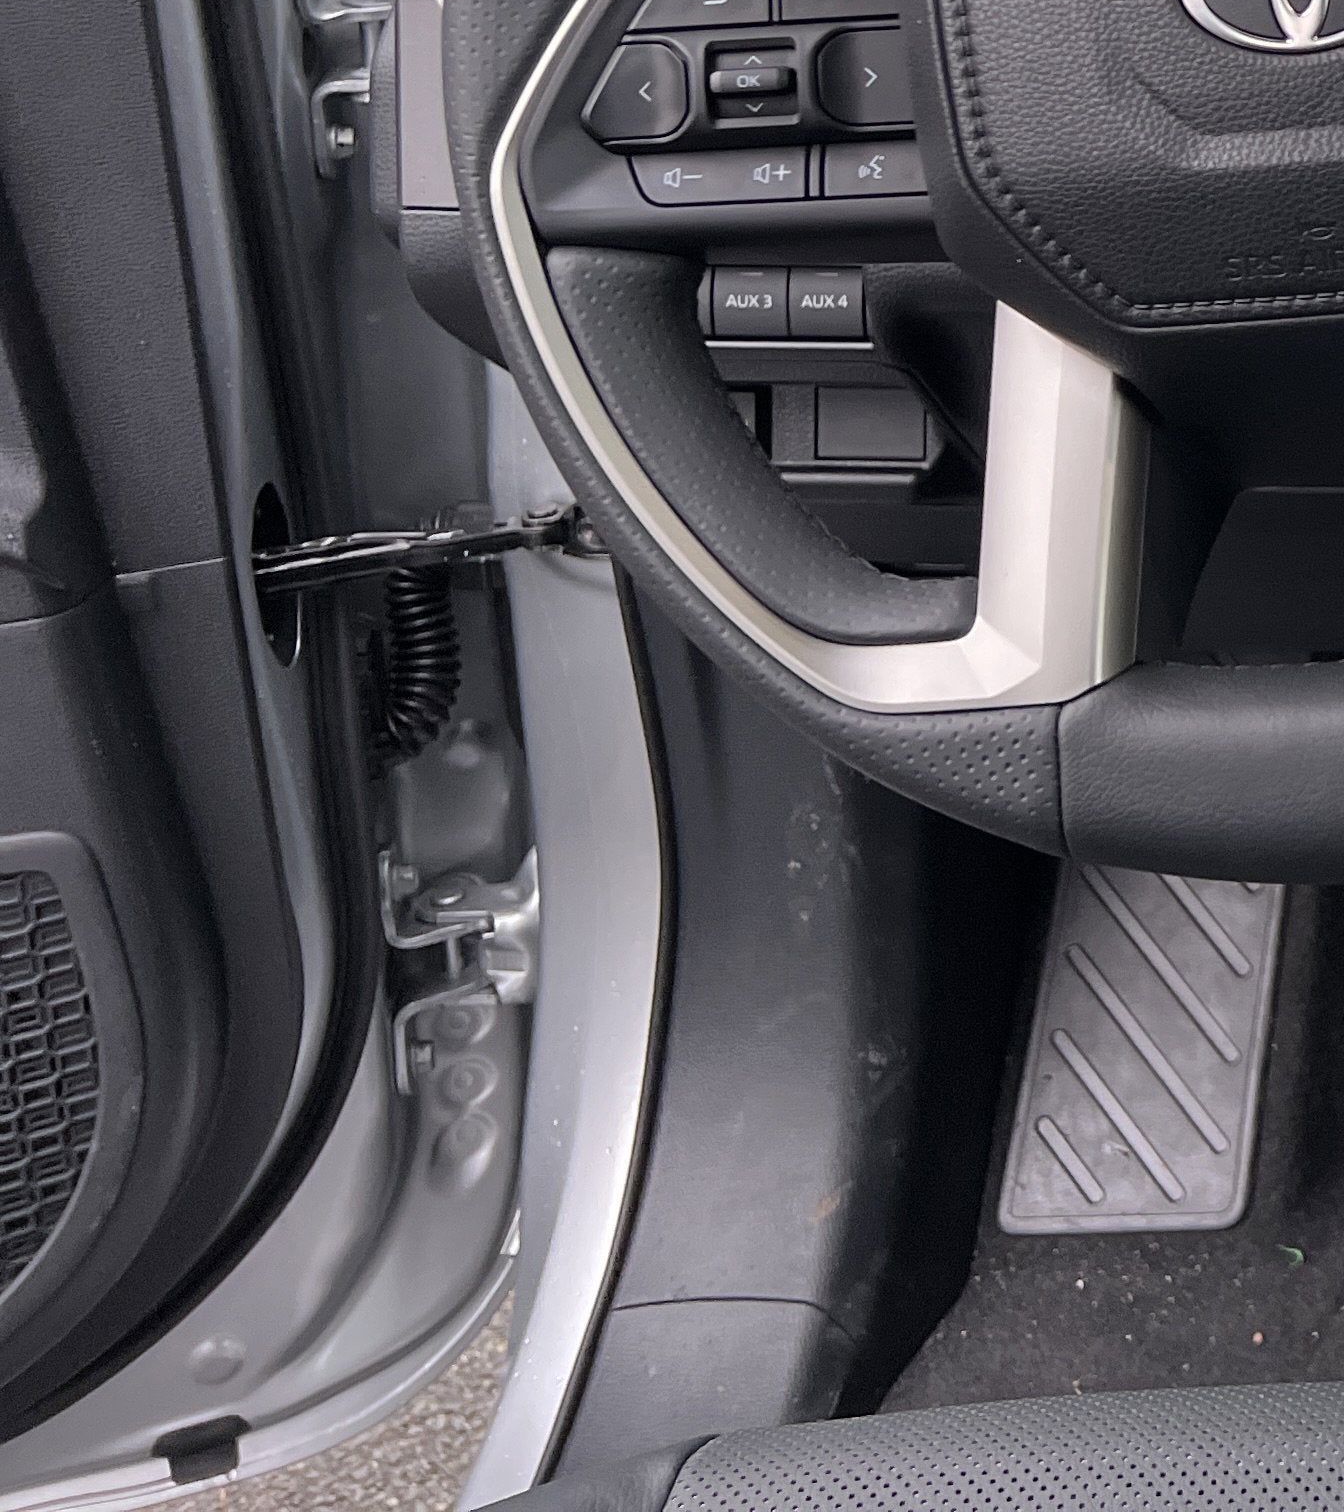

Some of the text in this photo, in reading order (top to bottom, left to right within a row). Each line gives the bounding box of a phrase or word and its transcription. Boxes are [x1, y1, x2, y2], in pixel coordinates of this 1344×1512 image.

[736, 74, 761, 88] OK
[725, 294, 773, 309] AUX 3
[801, 294, 849, 309] AUX 4
